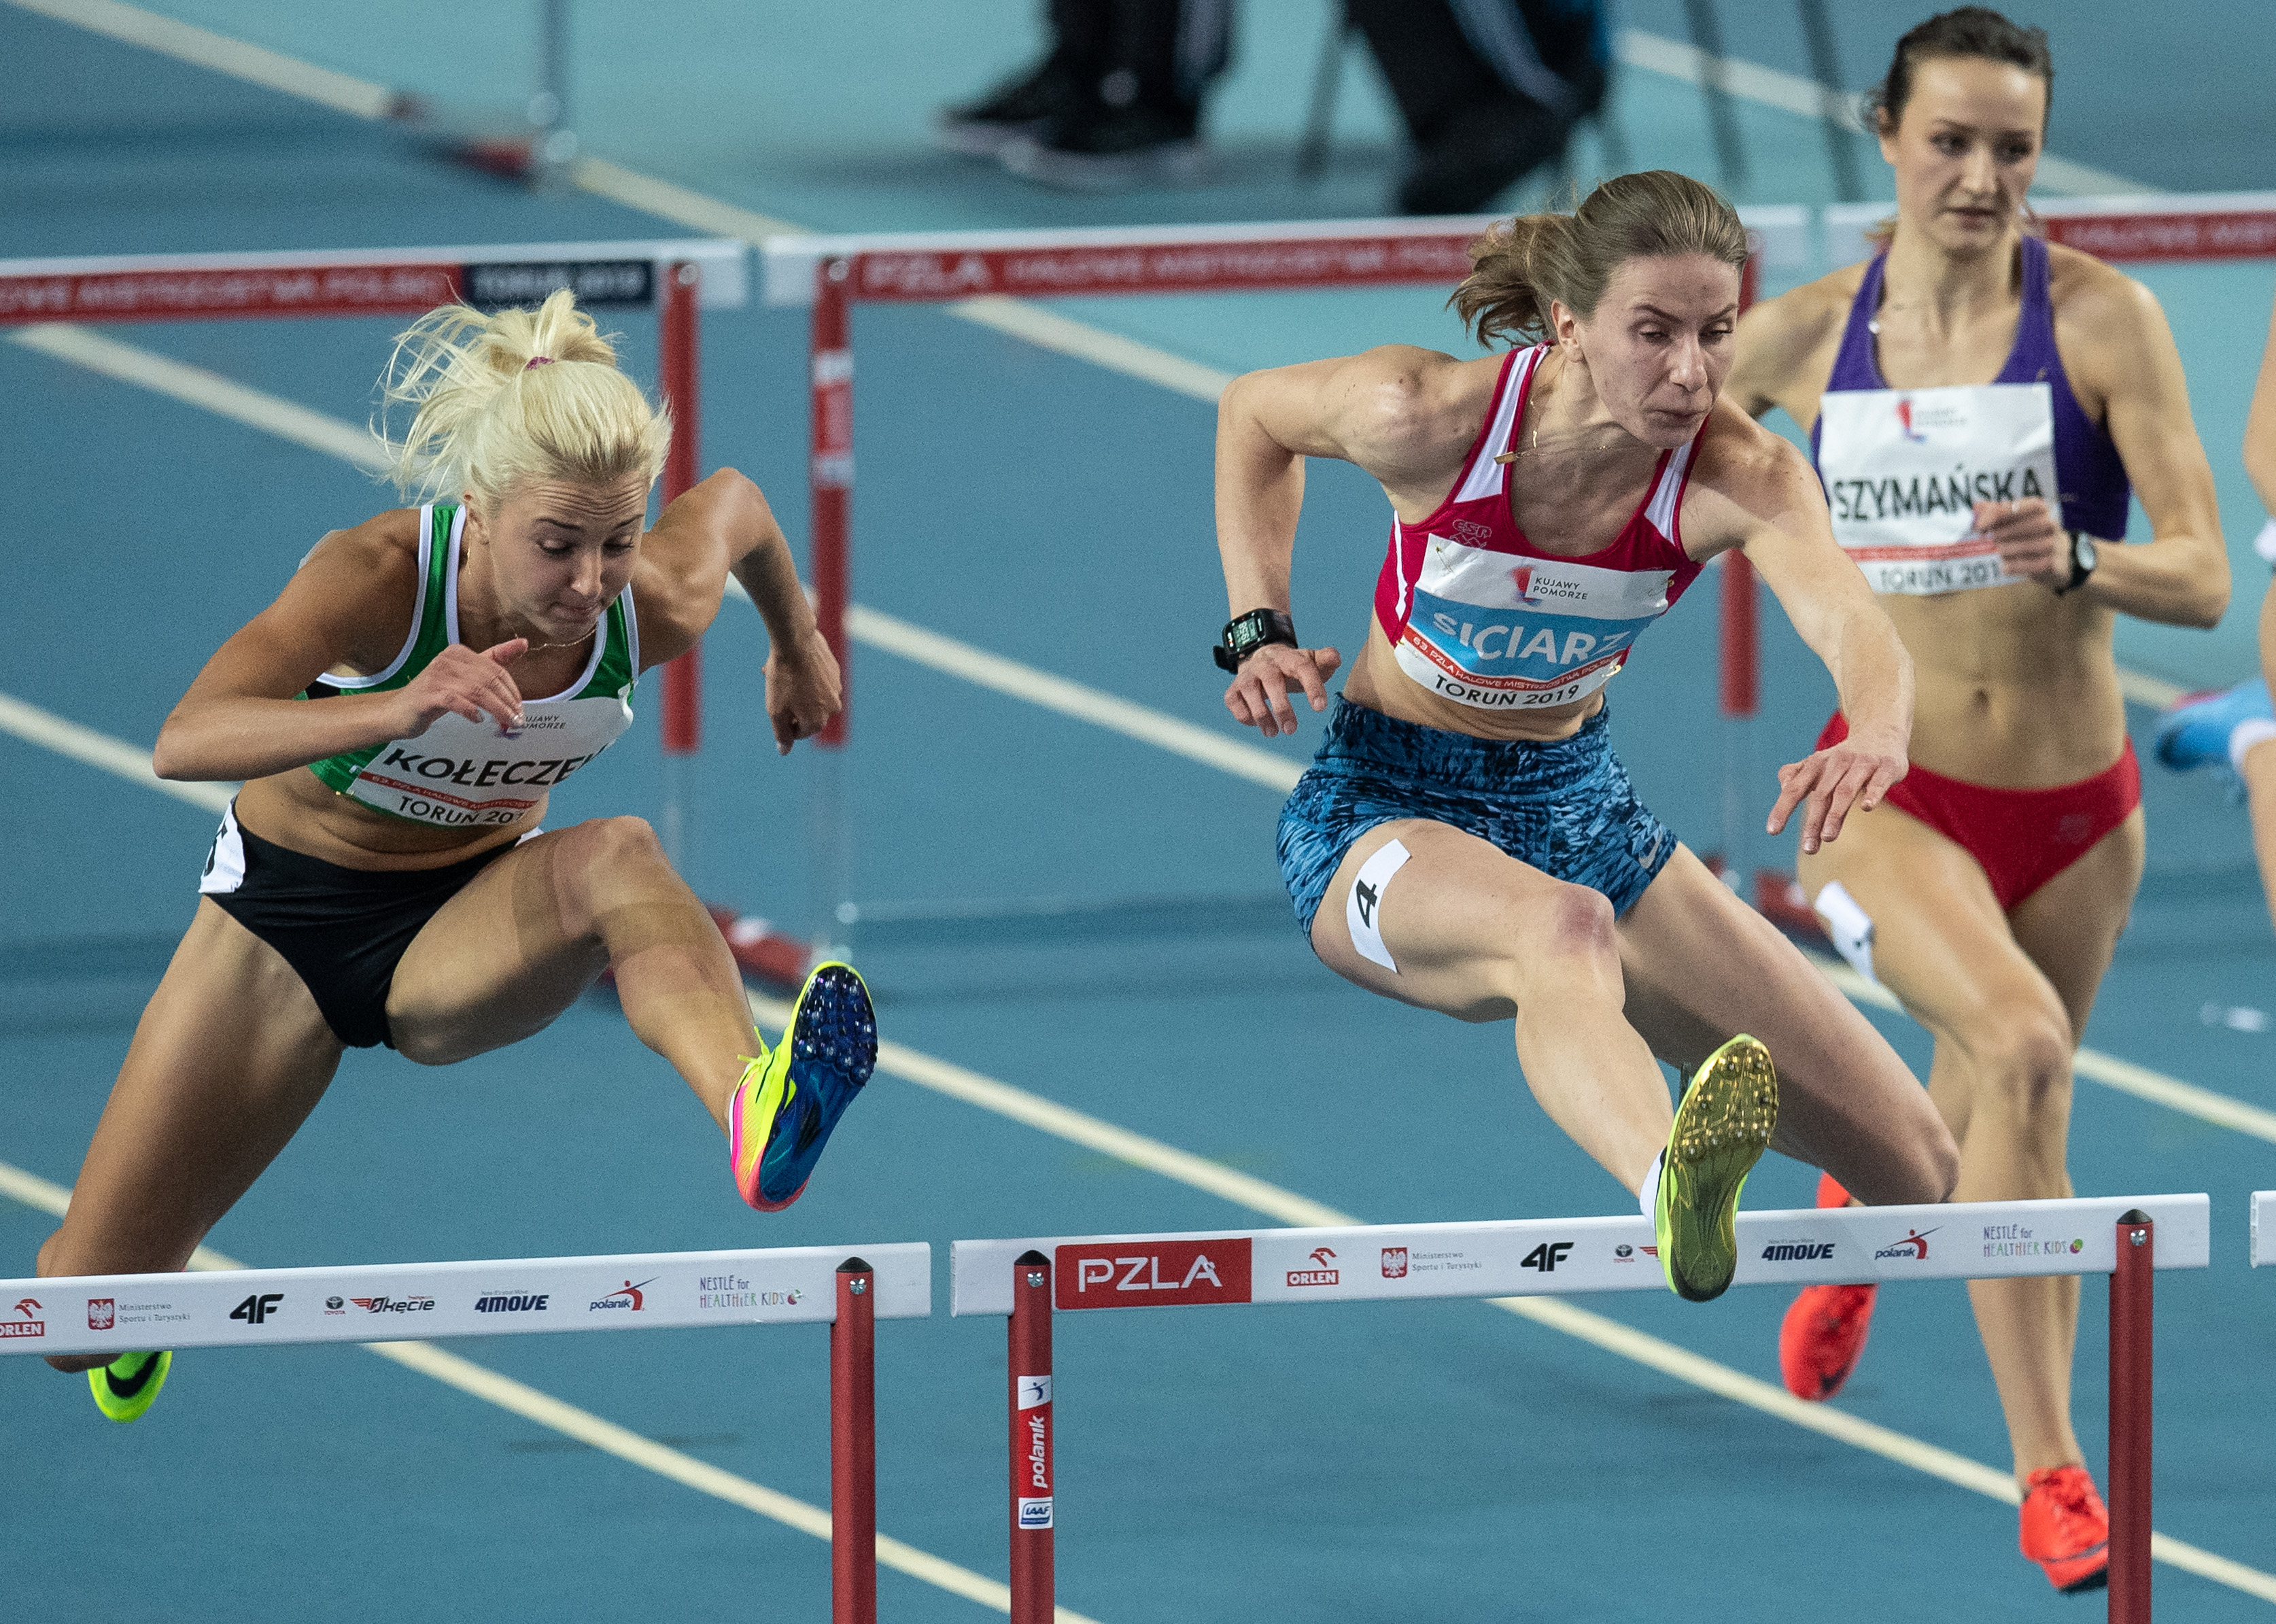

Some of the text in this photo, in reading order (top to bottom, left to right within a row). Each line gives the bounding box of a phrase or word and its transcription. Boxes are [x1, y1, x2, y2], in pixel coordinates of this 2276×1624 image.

[1833, 463, 2043, 521] SZYMAŃSKA
[1533, 585, 1588, 600] POMORZE
[1535, 576, 1580, 590] KUJAWY
[1432, 612, 1632, 665] SICIARZ
[1430, 650, 1454, 674] PZLA
[1455, 671, 1502, 687] HALOWE
[1435, 674, 1580, 705] TORUŃ 2019
[1356, 878, 1378, 929] 4
[2020, 1227, 2033, 1239] for
[1520, 1241, 1574, 1272] 4F
[1761, 1243, 1835, 1261] 4MOVE
[1874, 1247, 1916, 1260] polanik
[1078, 1254, 1223, 1292] PZLA
[1288, 1271, 1337, 1285] ORLEN
[737, 1279, 750, 1290] for
[229, 1293, 284, 1325] 4F
[475, 1294, 549, 1313] 4MOVE
[589, 1298, 631, 1311] polanik
[1028, 1415, 1049, 1489] polanik
[1026, 1506, 1050, 1515] IAAF
